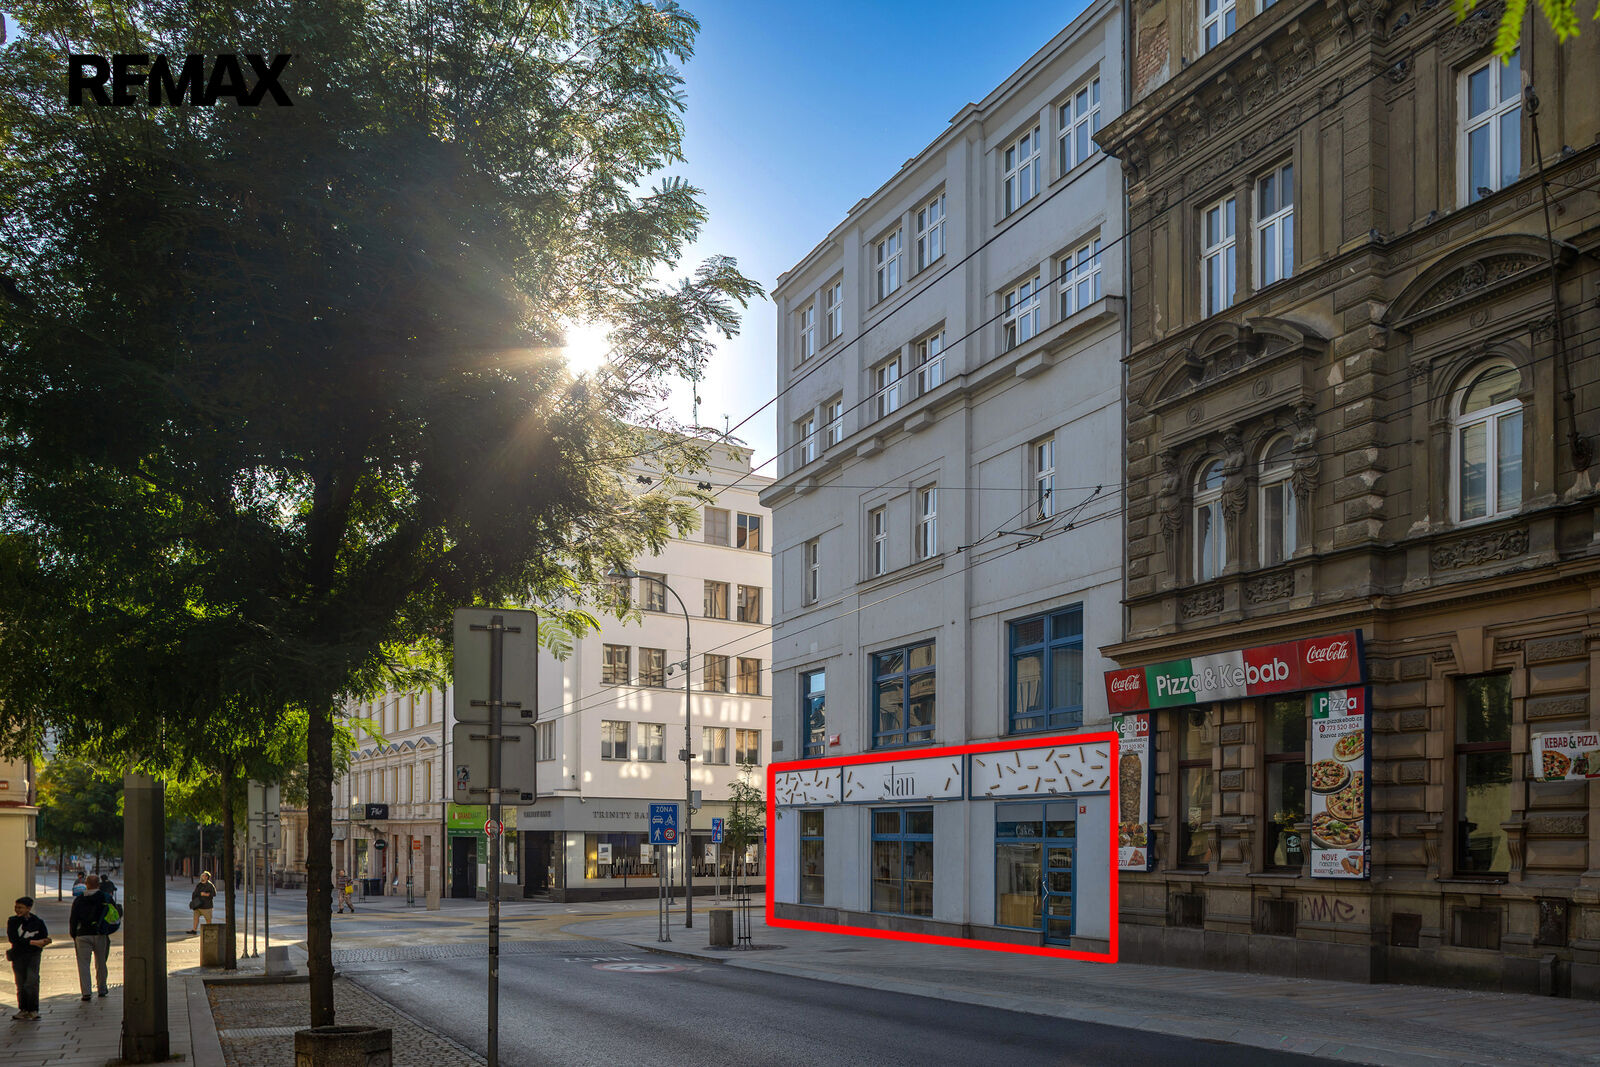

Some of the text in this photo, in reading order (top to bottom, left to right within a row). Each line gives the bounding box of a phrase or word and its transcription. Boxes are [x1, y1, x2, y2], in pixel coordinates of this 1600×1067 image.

[1306, 640, 1349, 664] Coca-Cola
[1156, 657, 1290, 698] Pizza & Kebab
[1319, 696, 1357, 712] Pizza
[1114, 719, 1148, 733] Kebab
[1544, 735, 1598, 749] KEBAB & PIZZA
[883, 765, 916, 797] stan
[592, 811, 649, 820] TRINITY BA
